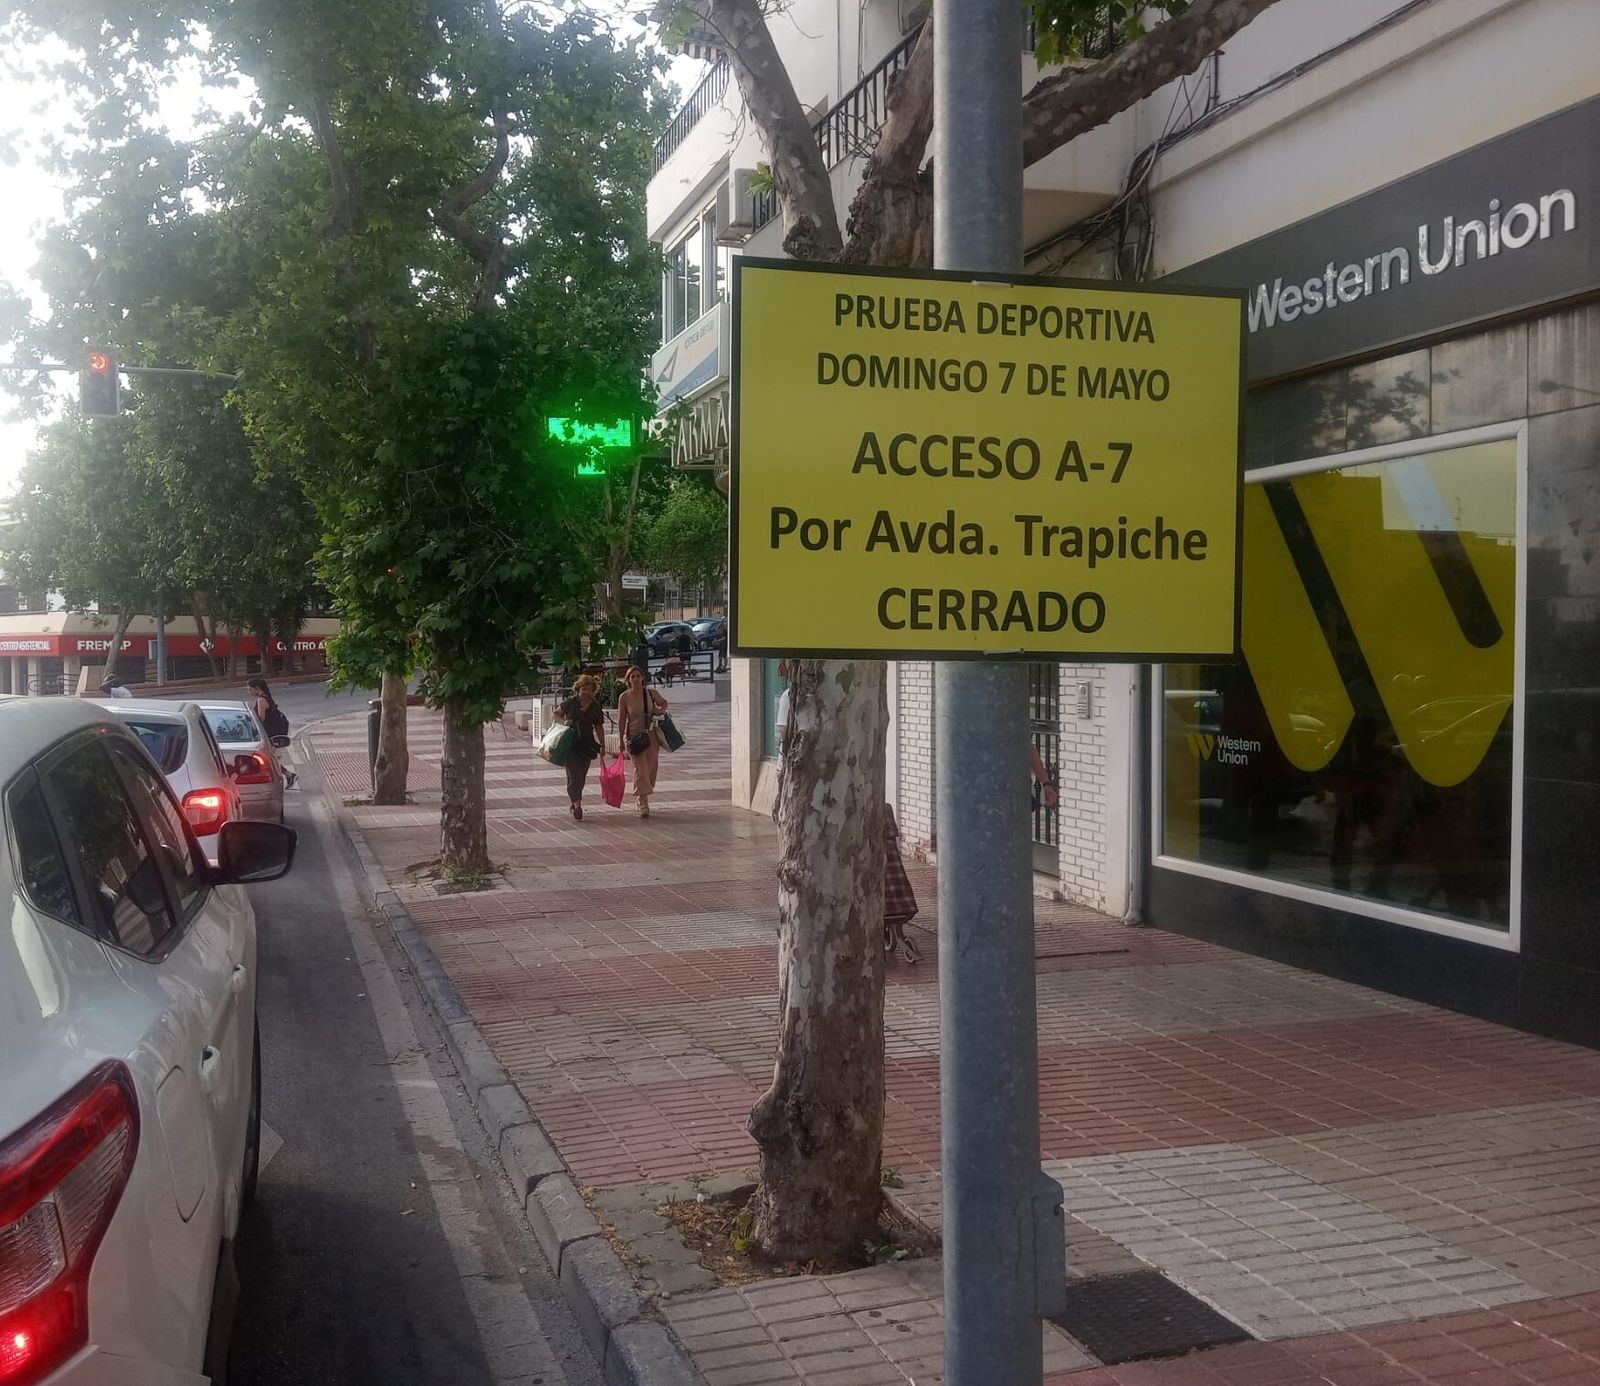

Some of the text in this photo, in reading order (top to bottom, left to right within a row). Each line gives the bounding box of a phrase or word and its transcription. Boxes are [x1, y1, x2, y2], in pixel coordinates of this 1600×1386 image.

[1248, 188, 1576, 334] Western Union
[835, 293, 1156, 344] PRUEBA DEPORTIVA
[817, 352, 1170, 402] DOMINGO 7 DE MAYO
[851, 431, 1133, 484] ACCESO A-7
[770, 506, 1208, 569] Por Avda. Trapiche
[877, 587, 1106, 634] CERRADO
[77, 640, 132, 651] FREMP
[276, 641, 316, 651] CNTRO
[1217, 735, 1261, 753] Western
[1217, 749, 1248, 766] Union
